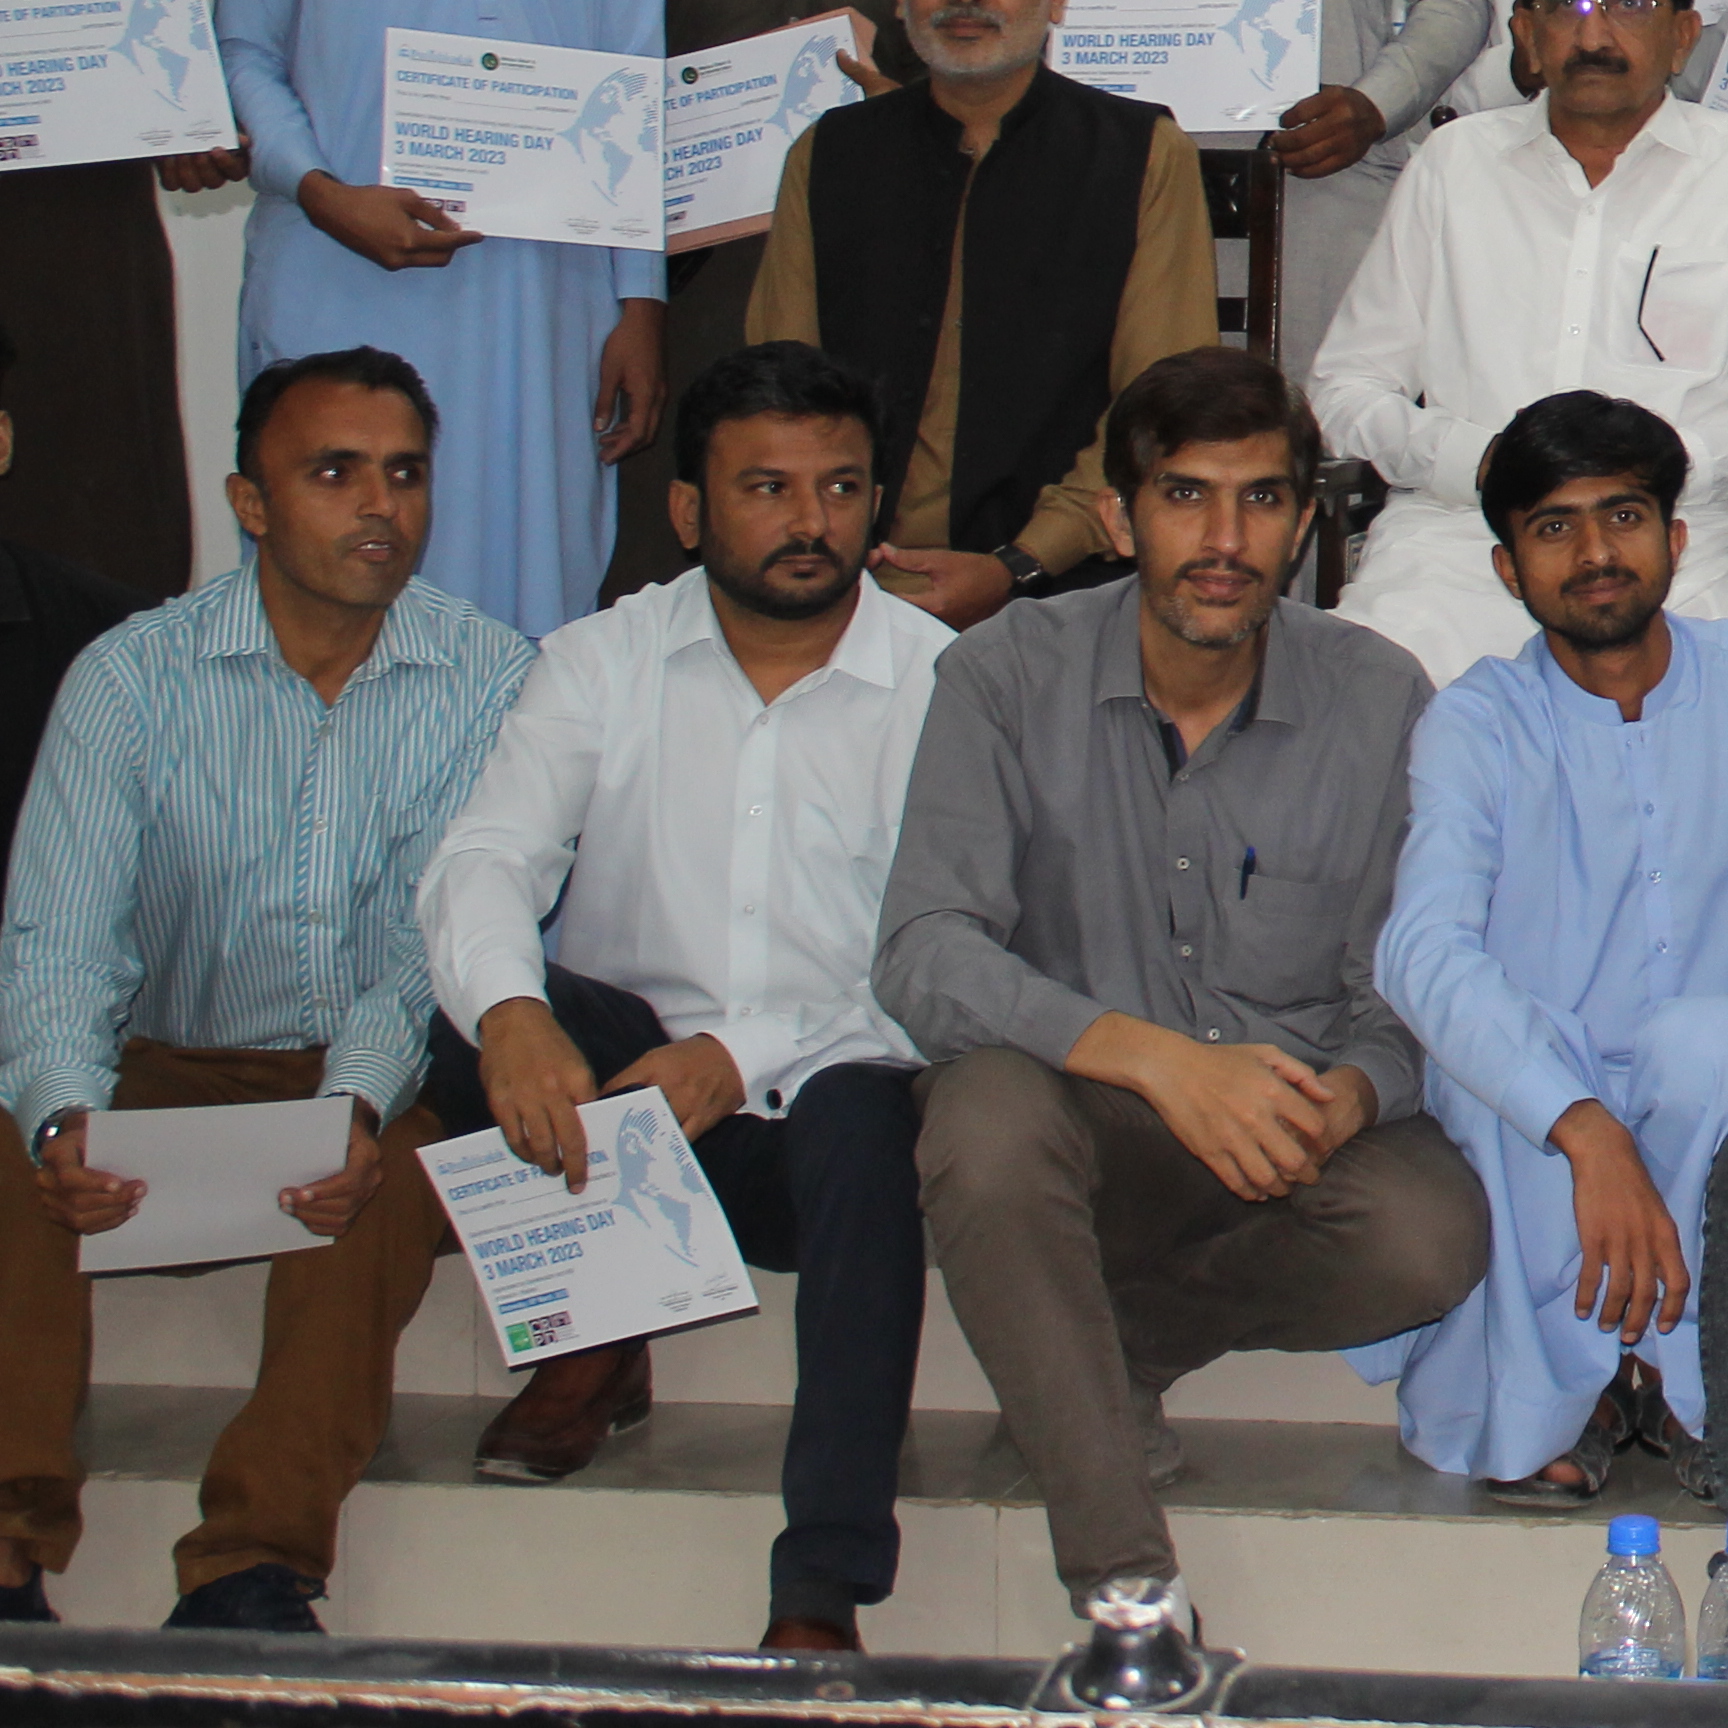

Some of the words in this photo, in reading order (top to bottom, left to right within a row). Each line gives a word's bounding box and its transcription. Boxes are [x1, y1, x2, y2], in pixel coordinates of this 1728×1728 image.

[1063, 34, 1114, 47] WORLD
[1119, 33, 1181, 47] HEARING
[1186, 33, 1216, 46] DAY
[1076, 51, 1128, 64] MARCH
[1133, 51, 1168, 64] 2023
